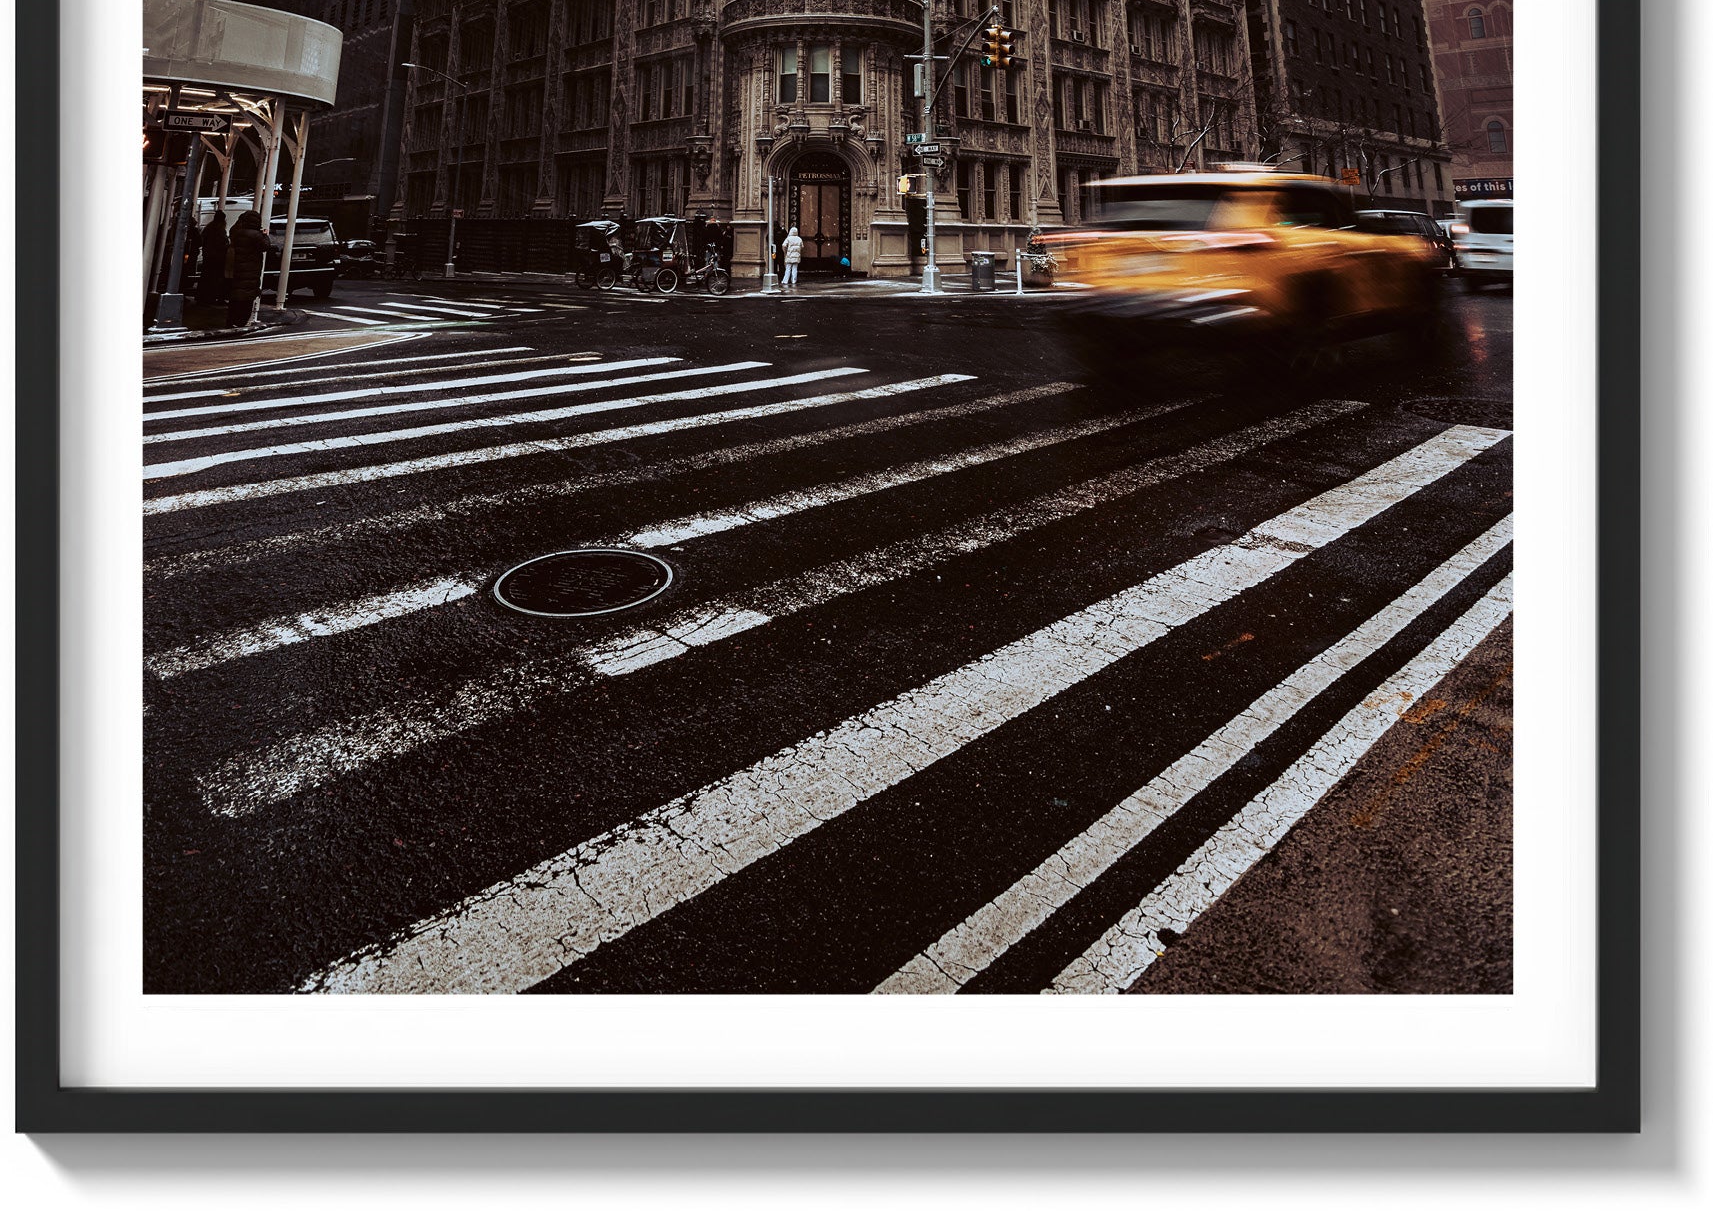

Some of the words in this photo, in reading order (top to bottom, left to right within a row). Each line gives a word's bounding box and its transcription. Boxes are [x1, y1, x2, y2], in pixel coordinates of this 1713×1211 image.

[173, 116, 194, 126] ONE
[202, 118, 222, 127] WAY
[1453, 185, 1468, 193] es
[1470, 182, 1482, 192] of
[1484, 181, 1506, 191] this
